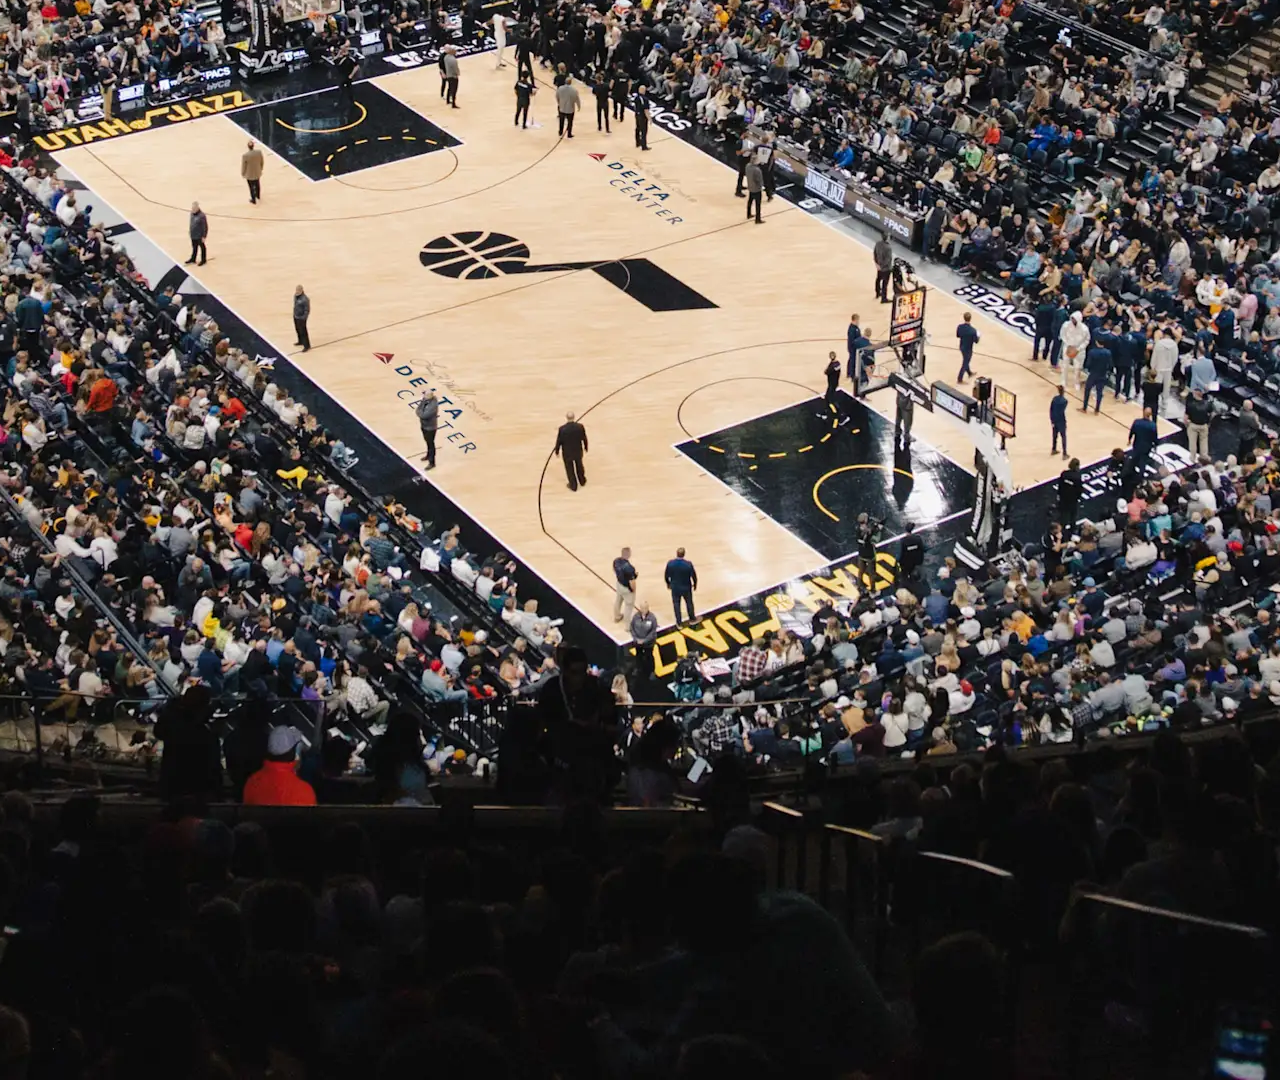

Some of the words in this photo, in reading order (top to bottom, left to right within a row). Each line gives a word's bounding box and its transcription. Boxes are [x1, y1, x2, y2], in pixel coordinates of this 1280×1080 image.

[206, 67, 230, 81] PACS
[33, 118, 132, 151] UTAH
[167, 91, 254, 121] JAZZ
[648, 100, 692, 130] ACS
[607, 162, 670, 201] DELTA
[805, 171, 829, 196] JUNIOR
[829, 183, 846, 205] JAZZ
[610, 180, 683, 225] CENTER
[889, 220, 908, 237] PACS
[394, 366, 462, 419] DETA
[398, 390, 476, 453] CETER
